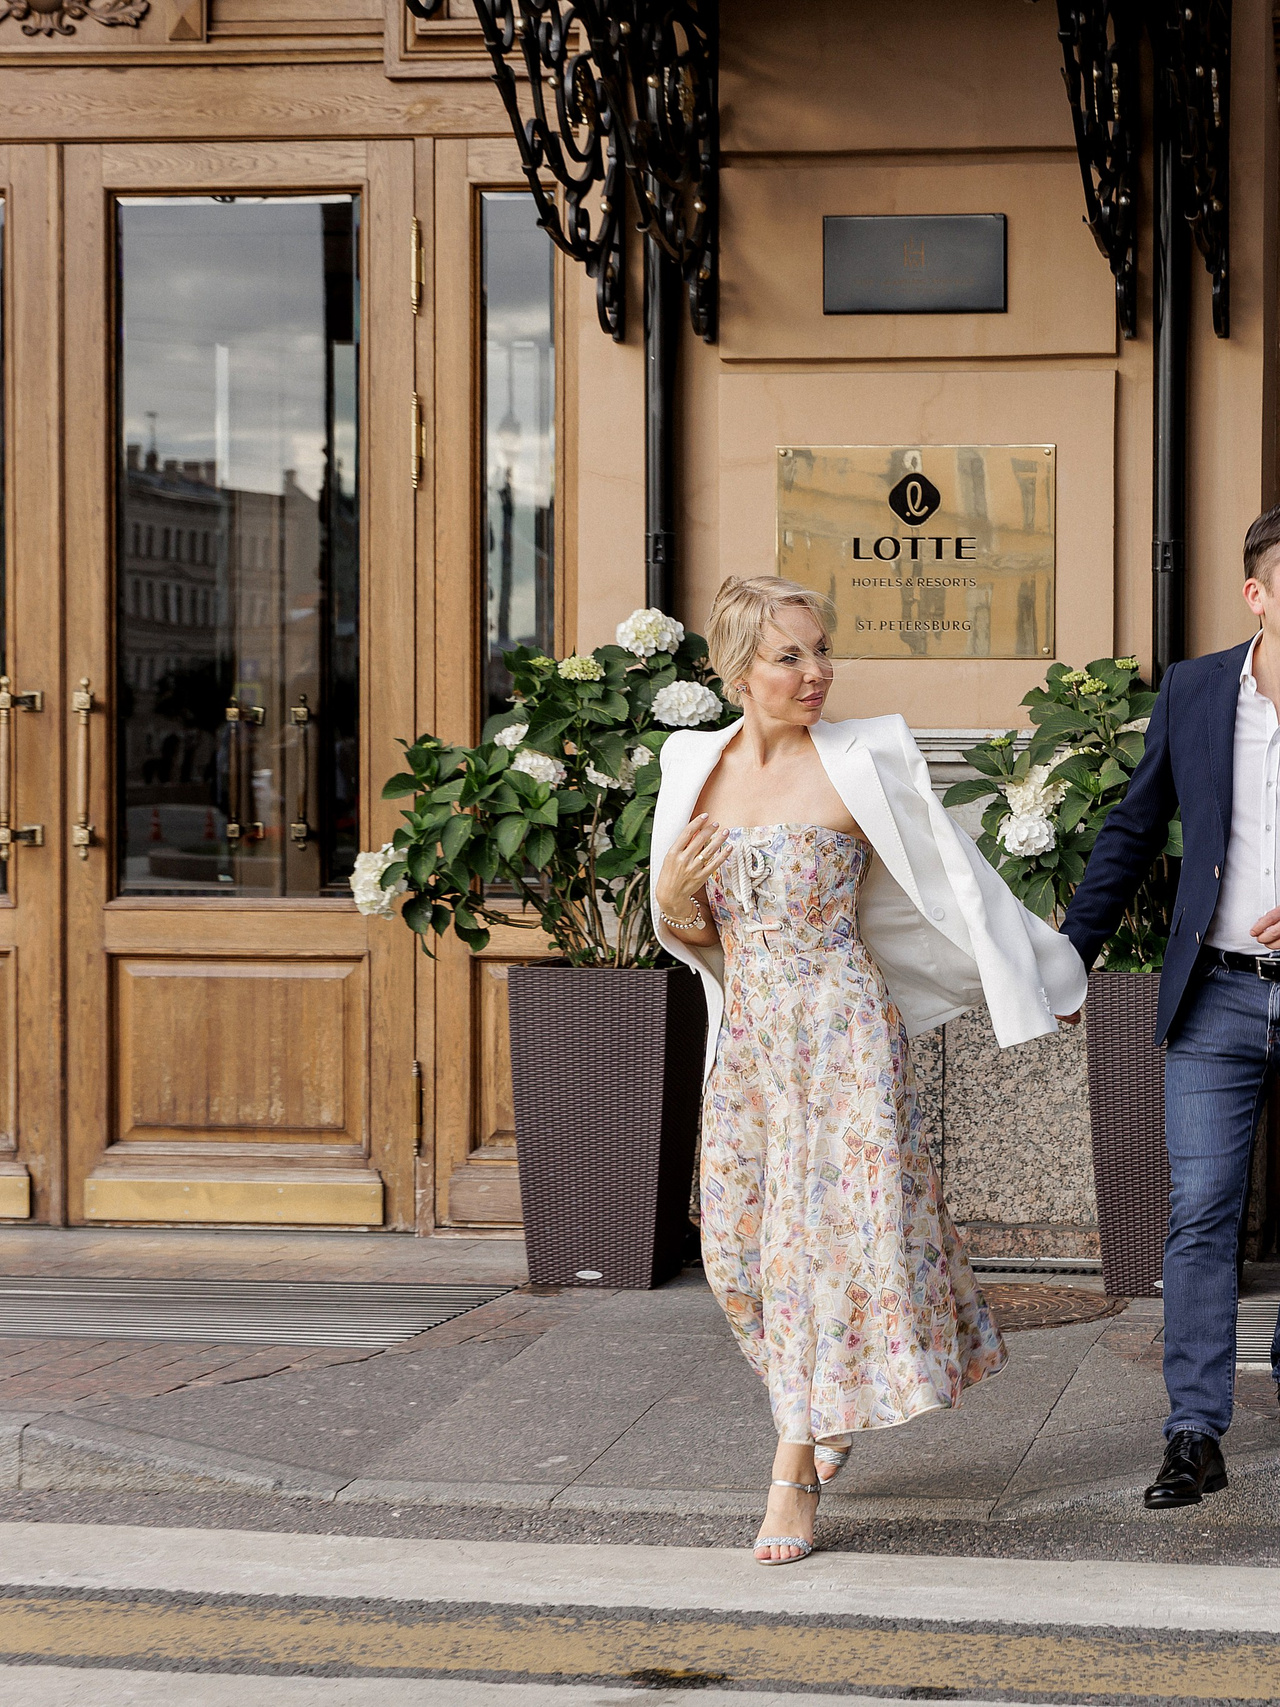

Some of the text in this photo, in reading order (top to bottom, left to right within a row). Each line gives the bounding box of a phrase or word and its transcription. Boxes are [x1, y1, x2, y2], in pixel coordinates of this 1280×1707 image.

[853, 536, 977, 560] LOTTE
[852, 578, 977, 588] HOTELS & RESORTS
[857, 620, 972, 631] ST. PETERSBURG
